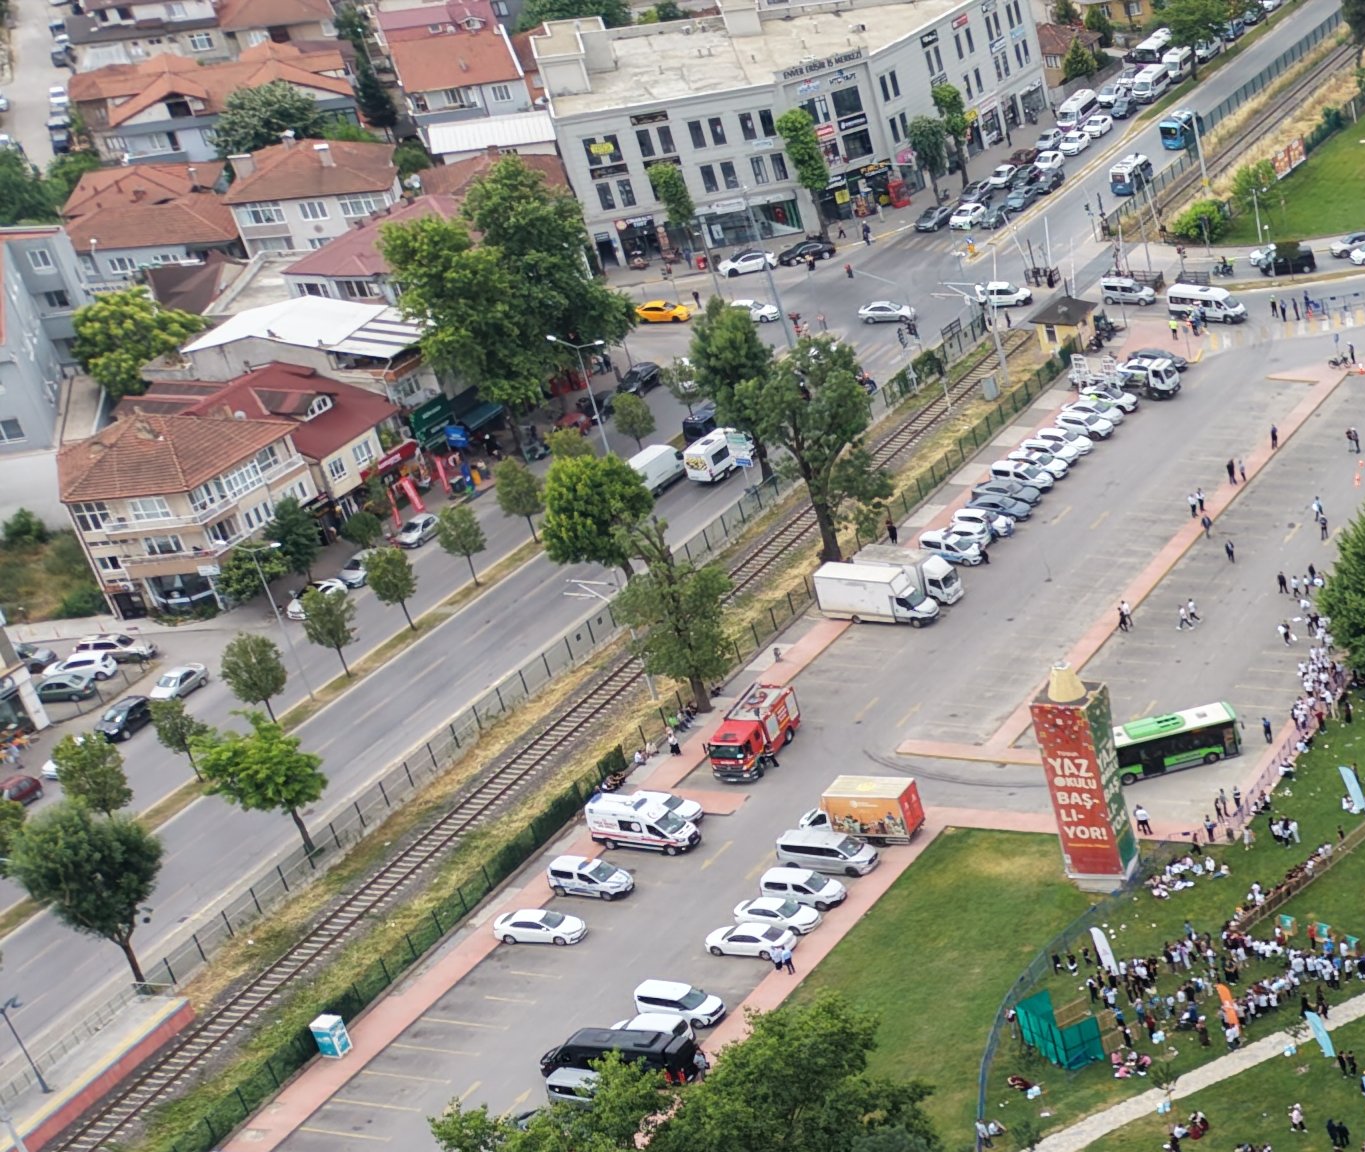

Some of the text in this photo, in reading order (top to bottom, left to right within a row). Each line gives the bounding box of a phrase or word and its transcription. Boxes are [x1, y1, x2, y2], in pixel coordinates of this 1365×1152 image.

[1047, 757, 1095, 778] YAZ
[1056, 791, 1101, 810] BAŞ-
[1063, 825, 1108, 841] YOR!
